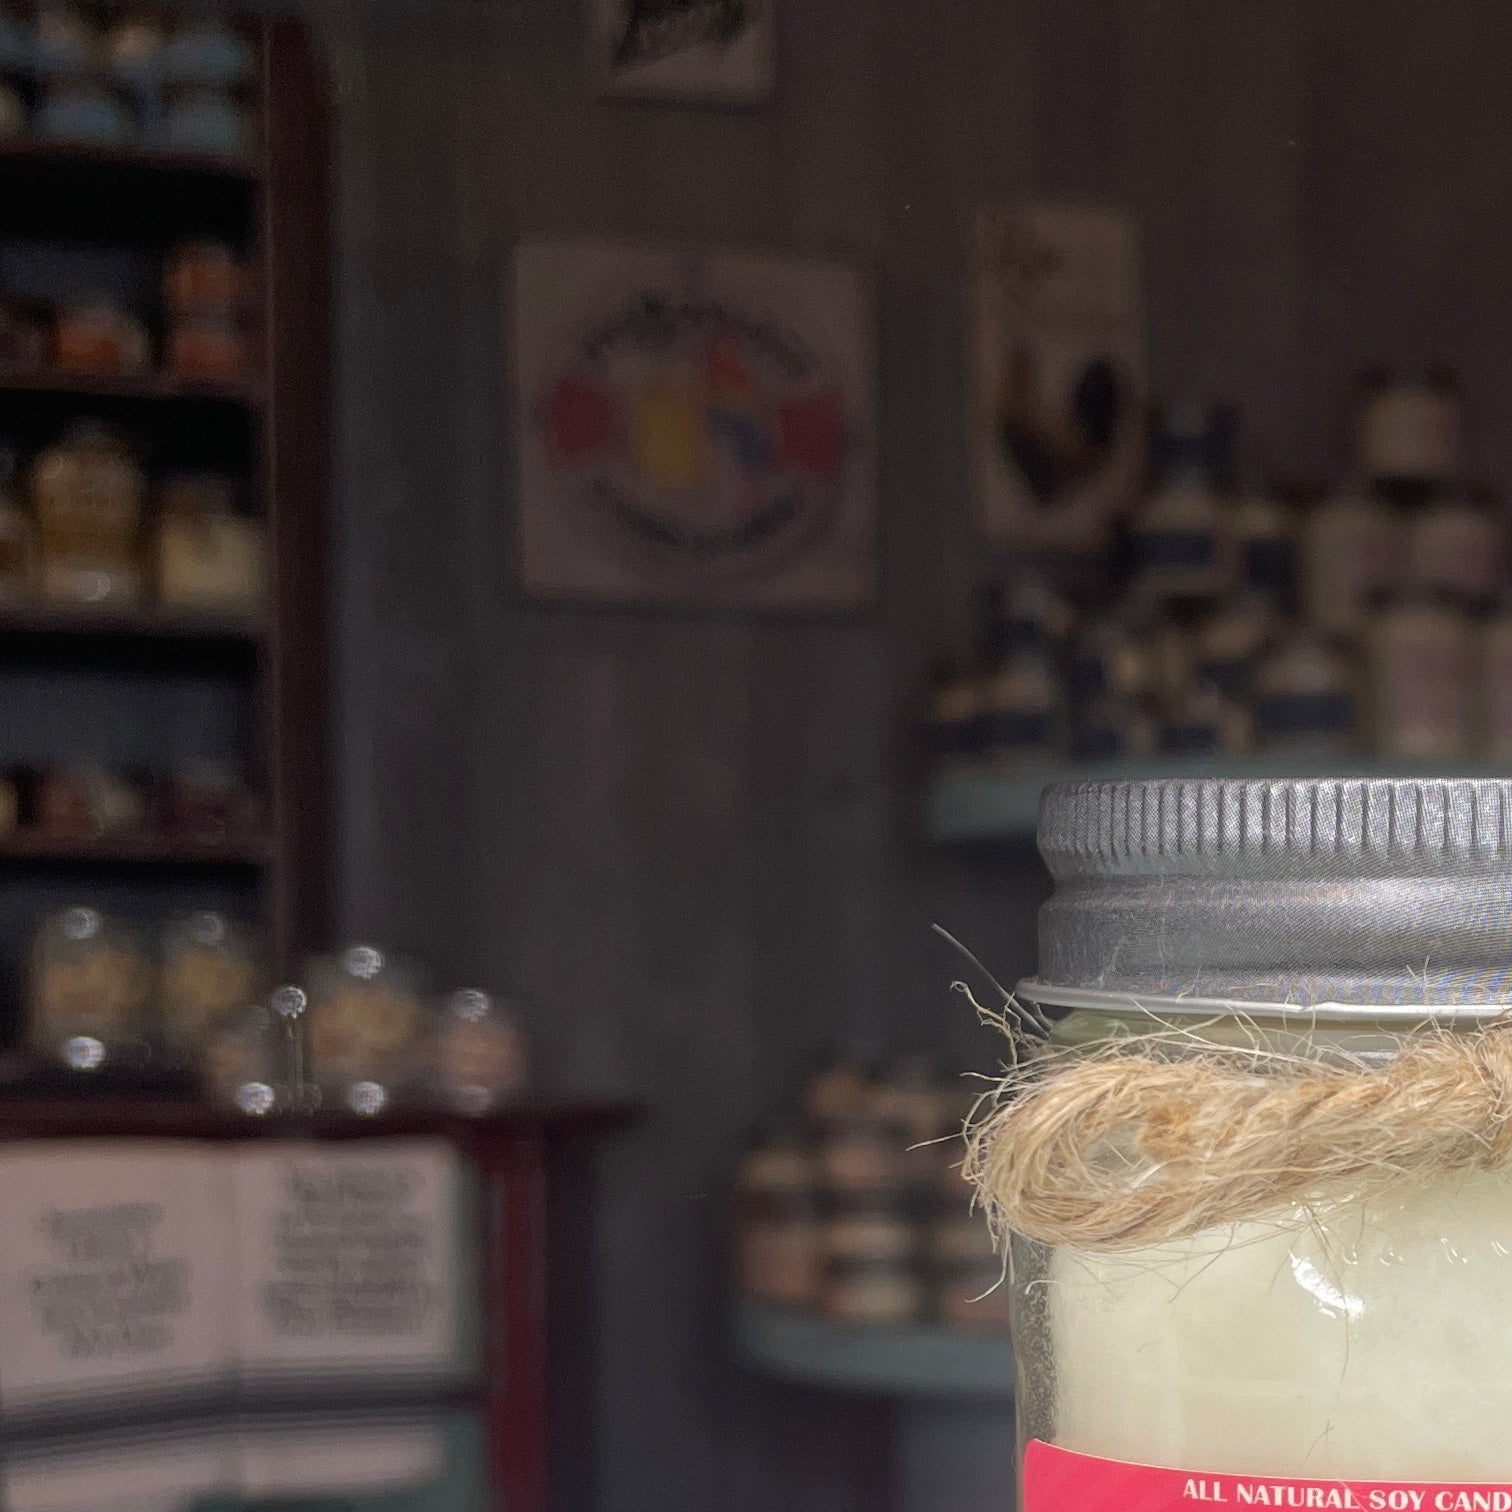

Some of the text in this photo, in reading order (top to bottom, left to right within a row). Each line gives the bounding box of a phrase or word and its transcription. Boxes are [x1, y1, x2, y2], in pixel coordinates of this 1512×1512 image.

[1183, 1478, 1228, 1503] ALL
[1236, 1483, 1361, 1510] NATURAL
[1368, 1489, 1426, 1512] SOY
